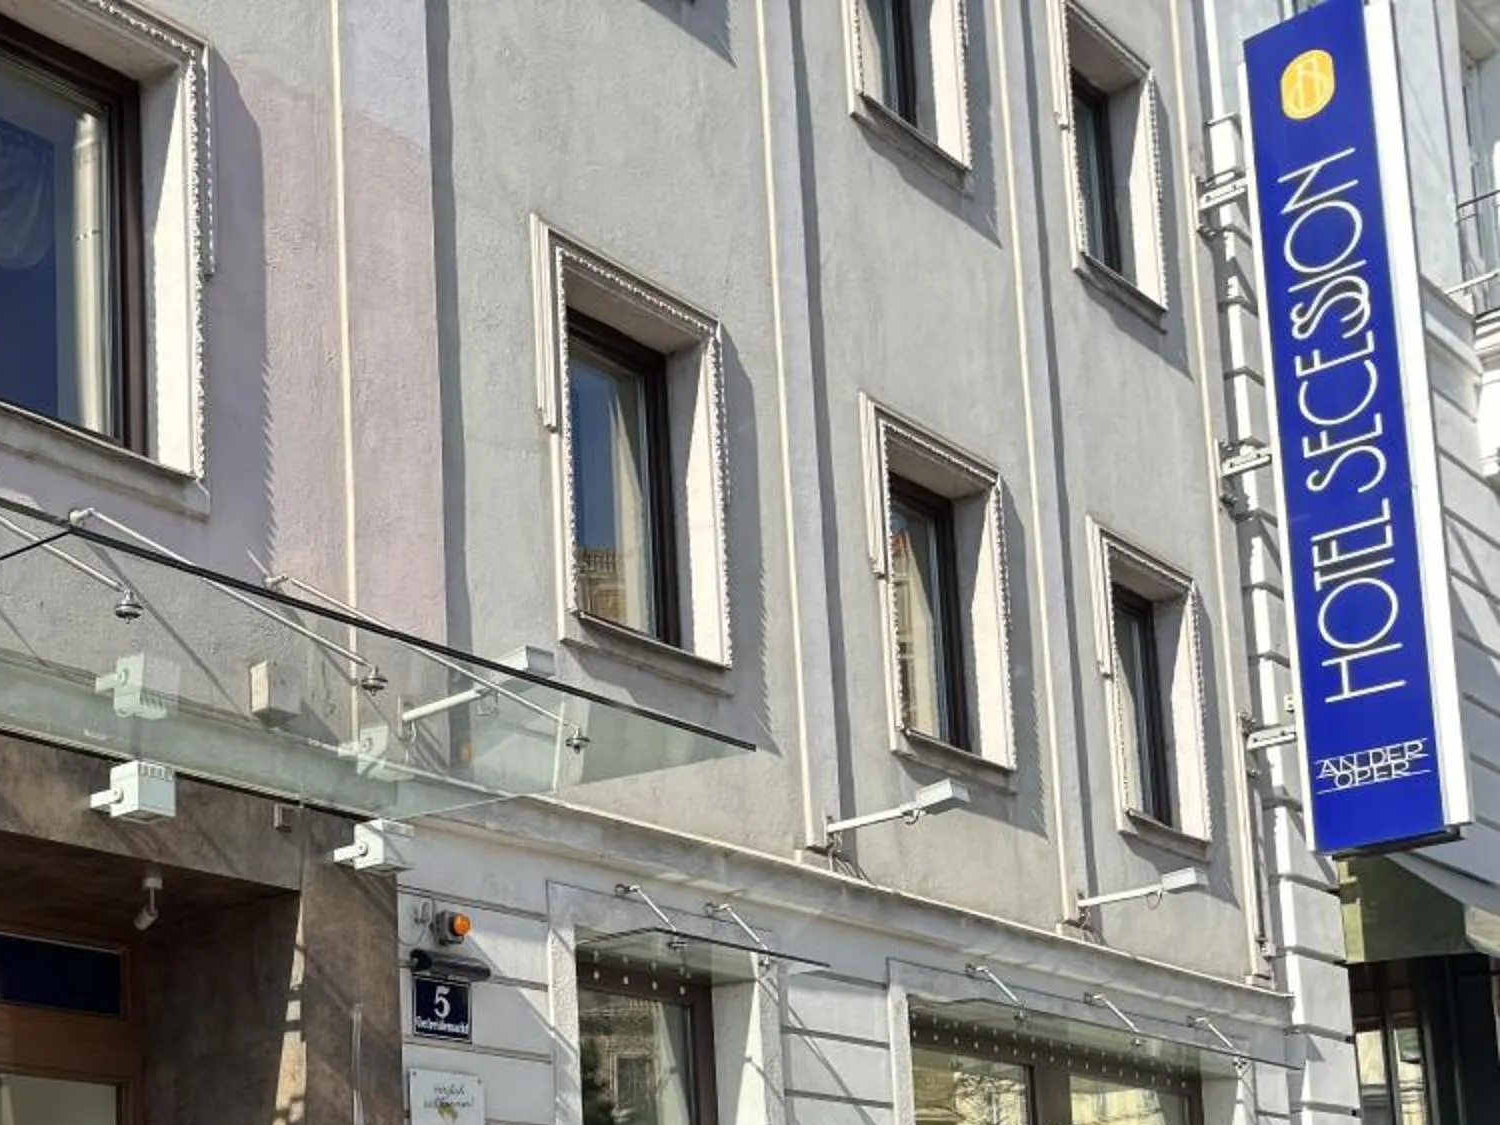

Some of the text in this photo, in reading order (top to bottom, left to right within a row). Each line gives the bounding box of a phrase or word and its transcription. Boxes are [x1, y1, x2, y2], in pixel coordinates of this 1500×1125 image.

[1277, 147, 1407, 704] HOTEL SECESSION
[1320, 739, 1423, 777] AN DER
[1333, 761, 1412, 789] OPER
[434, 985, 451, 1019] 5
